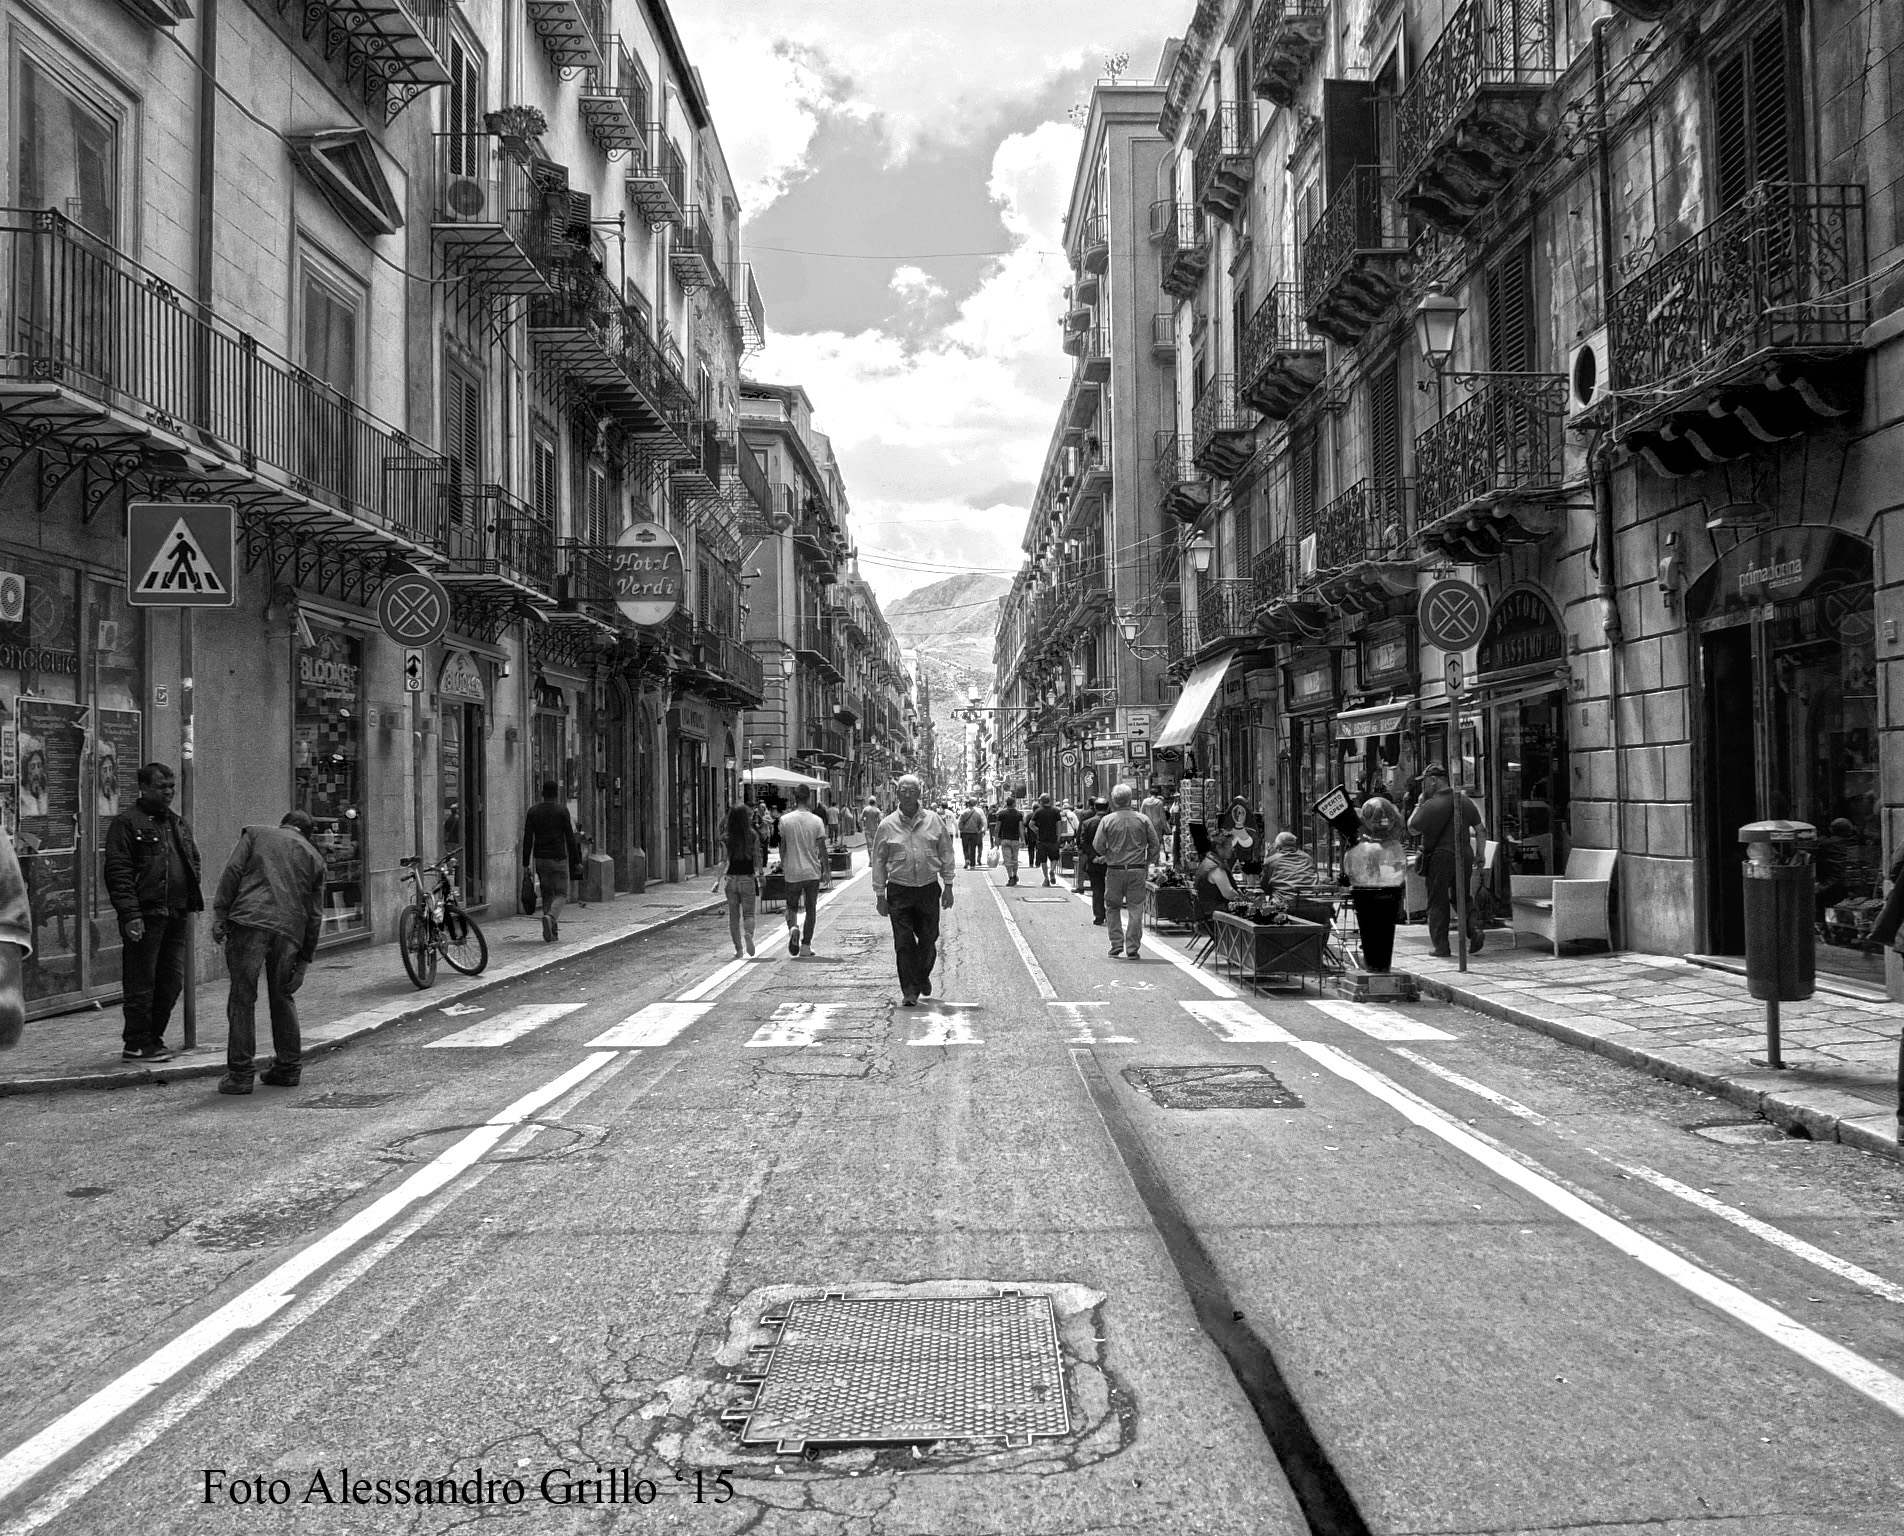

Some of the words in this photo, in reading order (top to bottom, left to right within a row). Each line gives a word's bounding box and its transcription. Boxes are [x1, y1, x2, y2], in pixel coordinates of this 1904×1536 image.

[613, 552, 676, 571] Hotel
[617, 576, 675, 595] Verdi
[1065, 755, 1074, 764] 10
[1321, 794, 1343, 812] APERTO
[1328, 802, 1345, 816] OPEN
[891, 1423, 941, 1432] WIND
